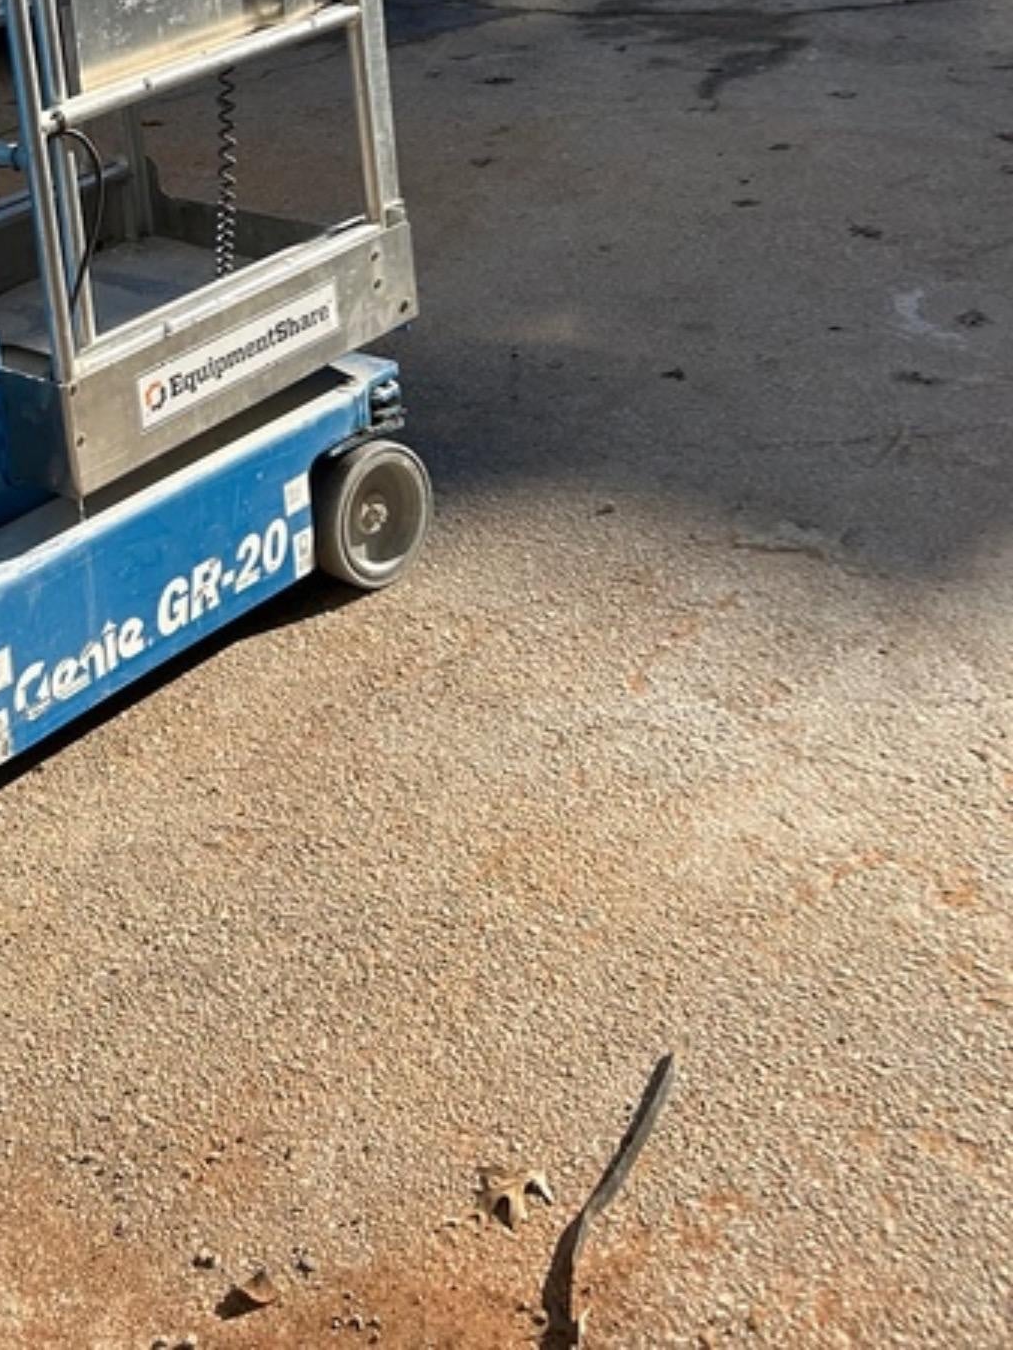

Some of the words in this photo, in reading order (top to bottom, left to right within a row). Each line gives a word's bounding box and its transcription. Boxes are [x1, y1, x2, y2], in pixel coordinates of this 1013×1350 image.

[169, 305, 330, 398] EquipmentShare
[14, 619, 146, 721] Genie
[156, 517, 288, 637] GR-20
